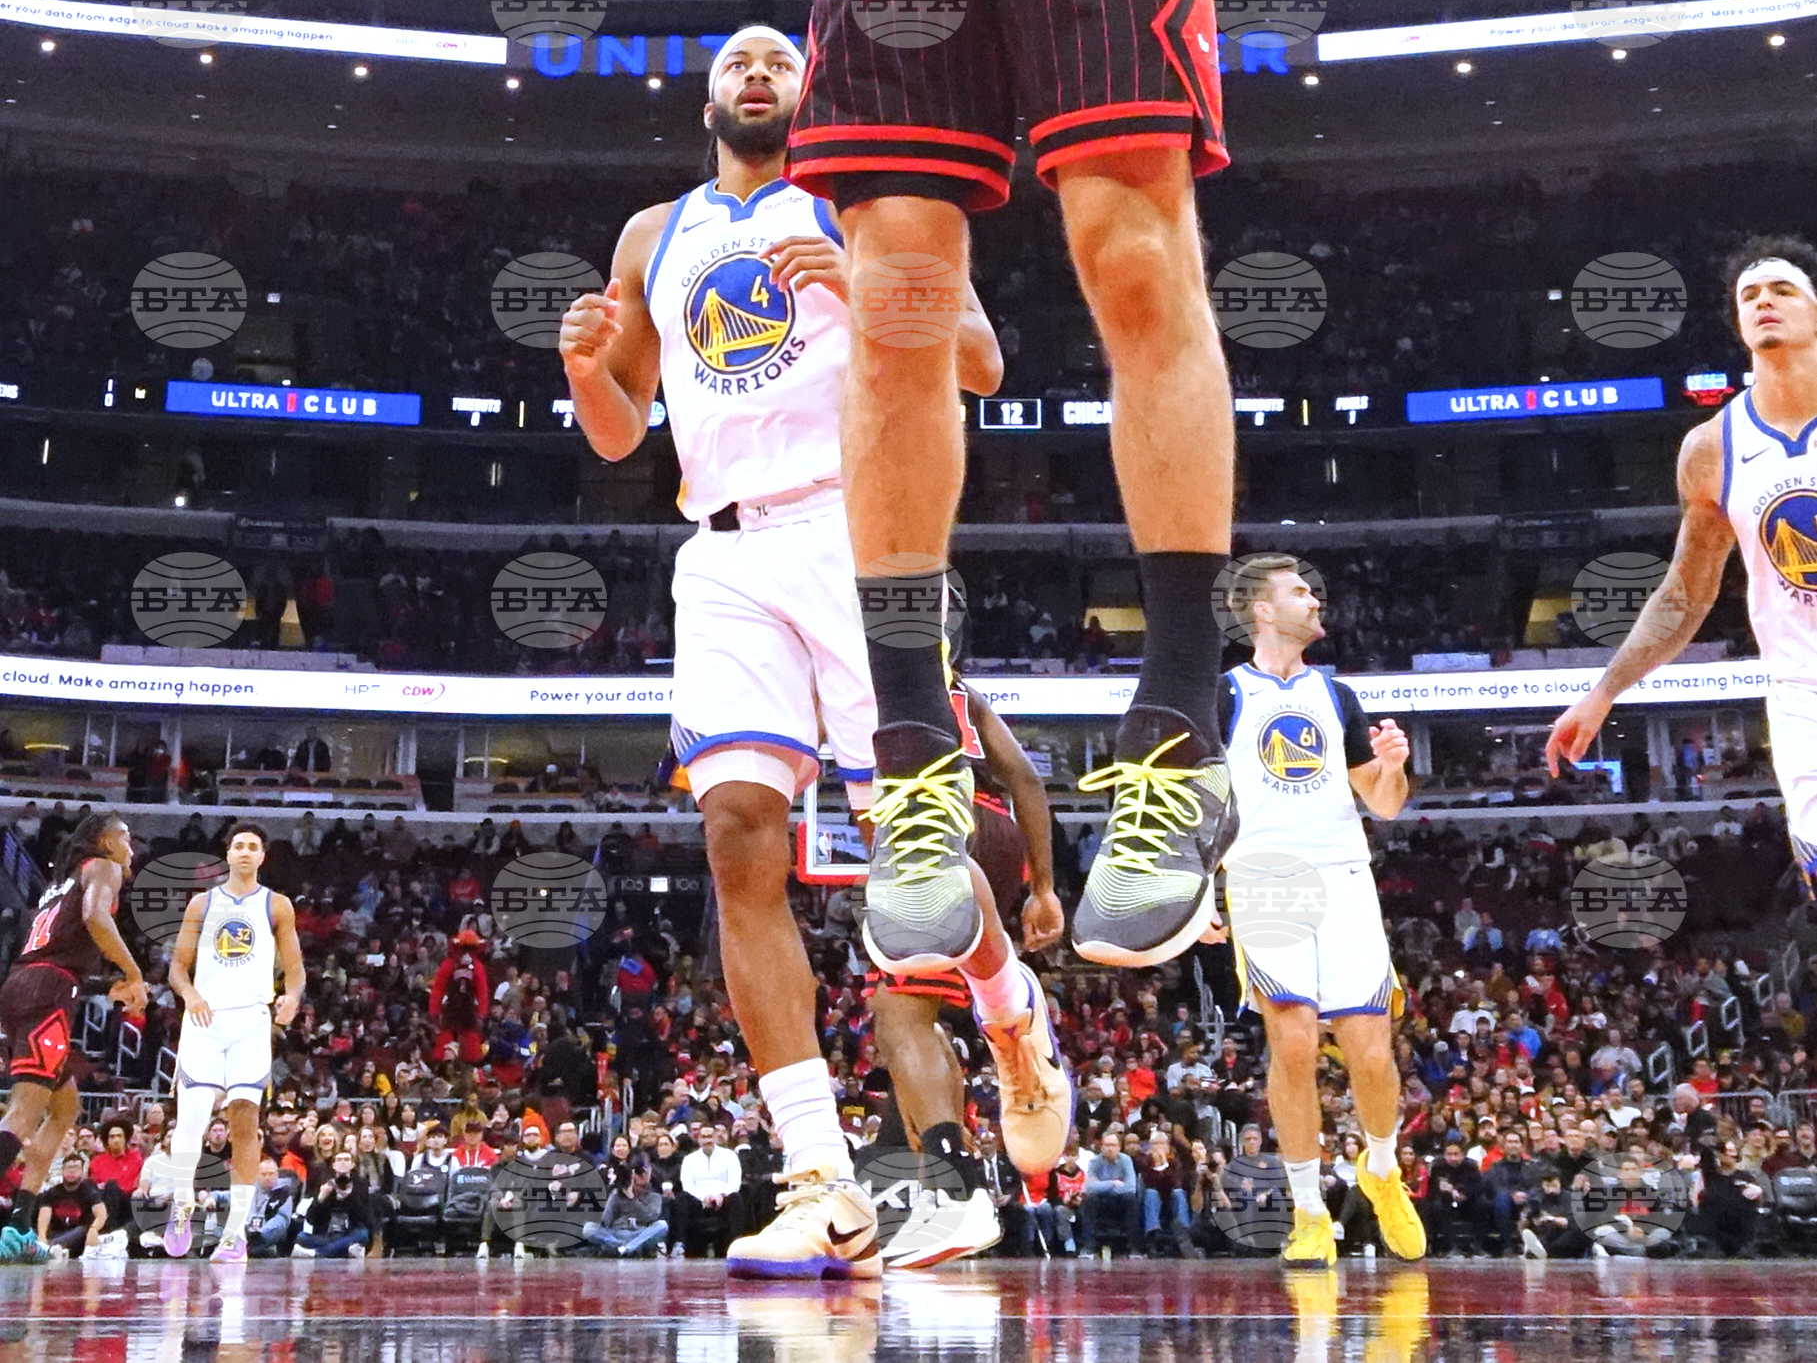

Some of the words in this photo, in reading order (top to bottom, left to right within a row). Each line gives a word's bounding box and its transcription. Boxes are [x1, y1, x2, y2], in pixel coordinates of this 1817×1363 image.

[76, 12, 105, 22] from
[108, 16, 137, 27] edge
[231, 26, 284, 39] amazing
[681, 237, 742, 288] GOLDEN
[750, 275, 770, 309] 4
[694, 336, 806, 395] WARRIORS
[212, 390, 279, 410] ULTRA
[304, 395, 377, 416] CLUB
[1451, 393, 1520, 413] ULTRA
[1543, 387, 1619, 408] CLUB
[1001, 402, 1023, 425] 12
[1753, 476, 1803, 516] GOLDEN
[59, 674, 104, 688] Make
[109, 678, 184, 695] amazing
[402, 685, 436, 697] CDW
[530, 690, 580, 702] Power
[585, 691, 621, 705] your
[626, 690, 664, 702] data
[1391, 686, 1430, 700] data
[1434, 684, 1474, 697] from
[1479, 684, 1518, 700] edge
[1524, 682, 1540, 694] to
[1652, 674, 1727, 690] amazing
[1255, 703, 1292, 729] GOLDEN
[1300, 727, 1316, 747] 61
[1262, 769, 1333, 795] WARRIORS
[22, 901, 62, 955] 11
[236, 927, 251, 941] 32
